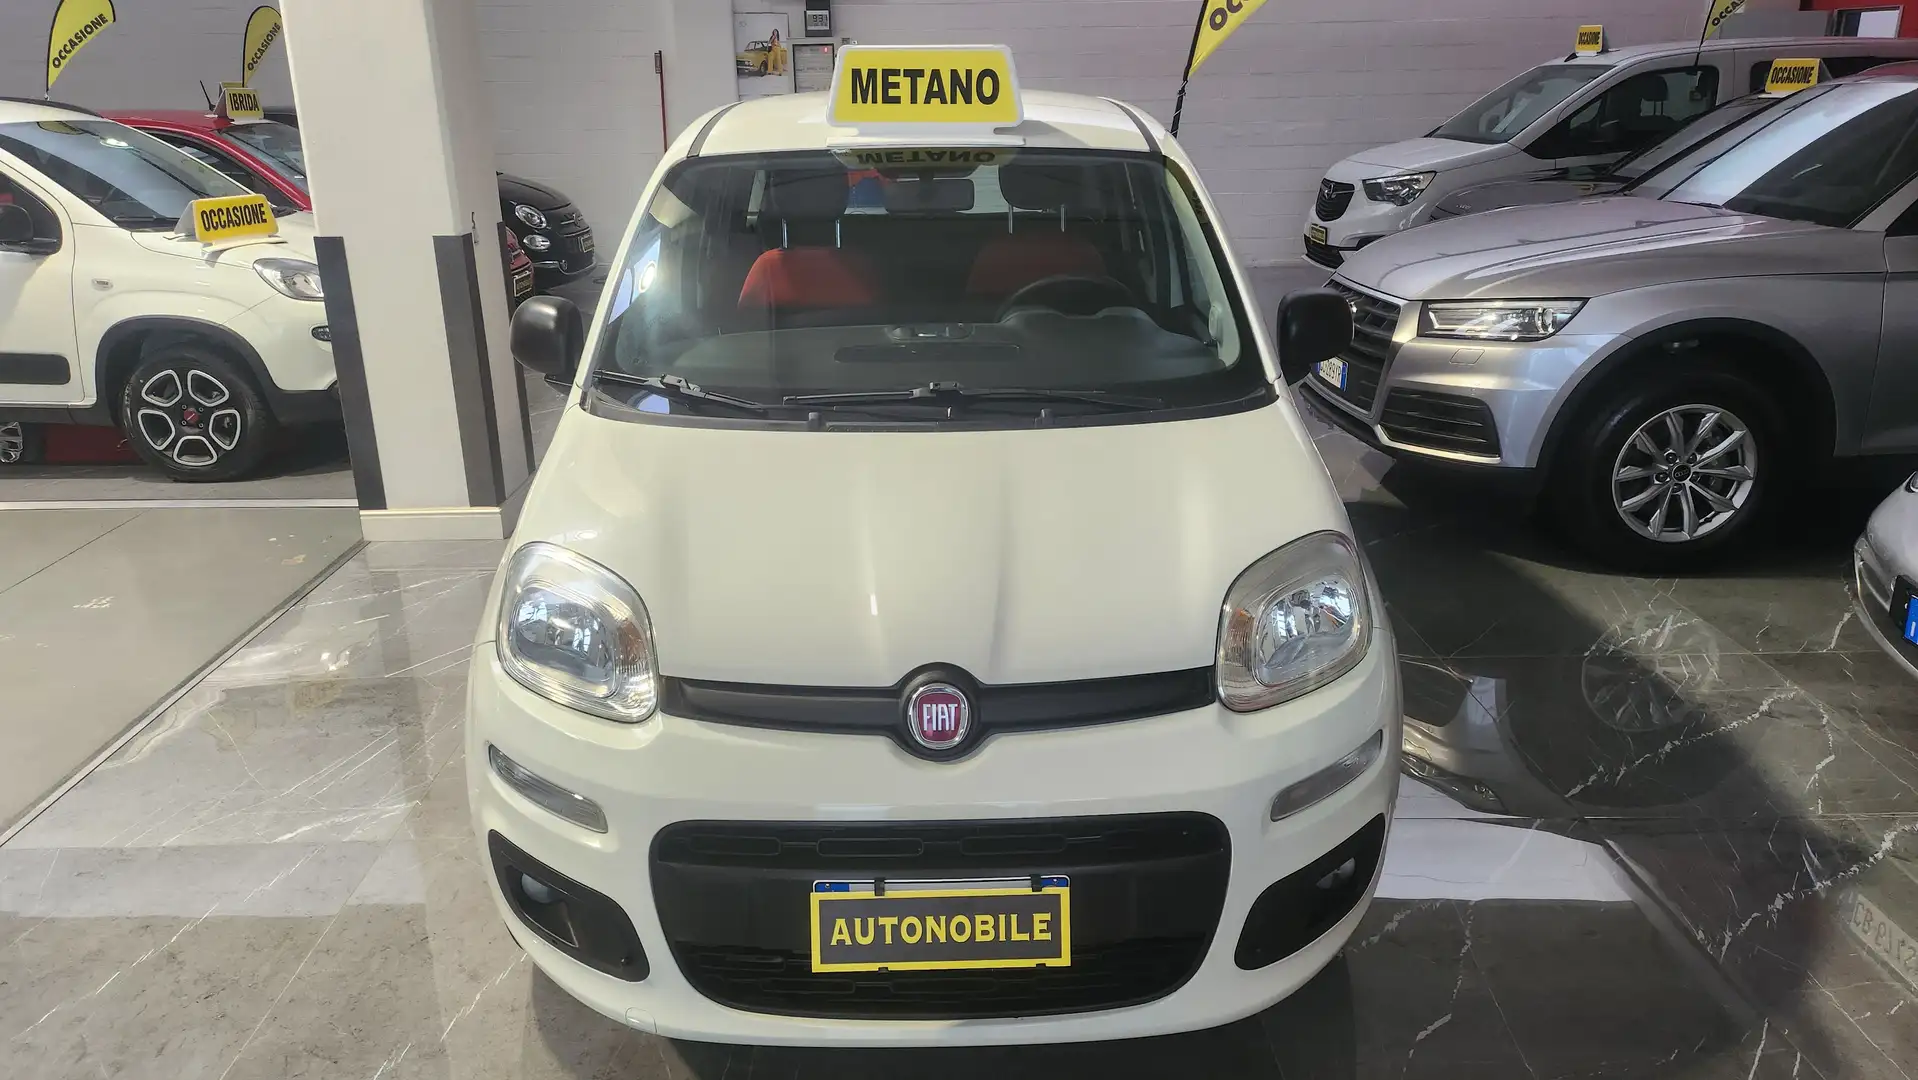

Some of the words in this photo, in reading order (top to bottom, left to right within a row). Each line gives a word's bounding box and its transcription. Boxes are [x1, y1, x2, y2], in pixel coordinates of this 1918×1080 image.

[1209, 0, 1249, 31] OC
[52, 13, 109, 69] OCCASIONE
[247, 22, 281, 71] OCCASIONE
[851, 68, 1000, 105] METANO
[1770, 66, 1815, 84] OCCASIONE
[229, 92, 260, 112] IBRIDA
[200, 202, 268, 232] OCCASIONE
[922, 703, 958, 731] FIAT
[830, 912, 1052, 946] AUTONOBILE
